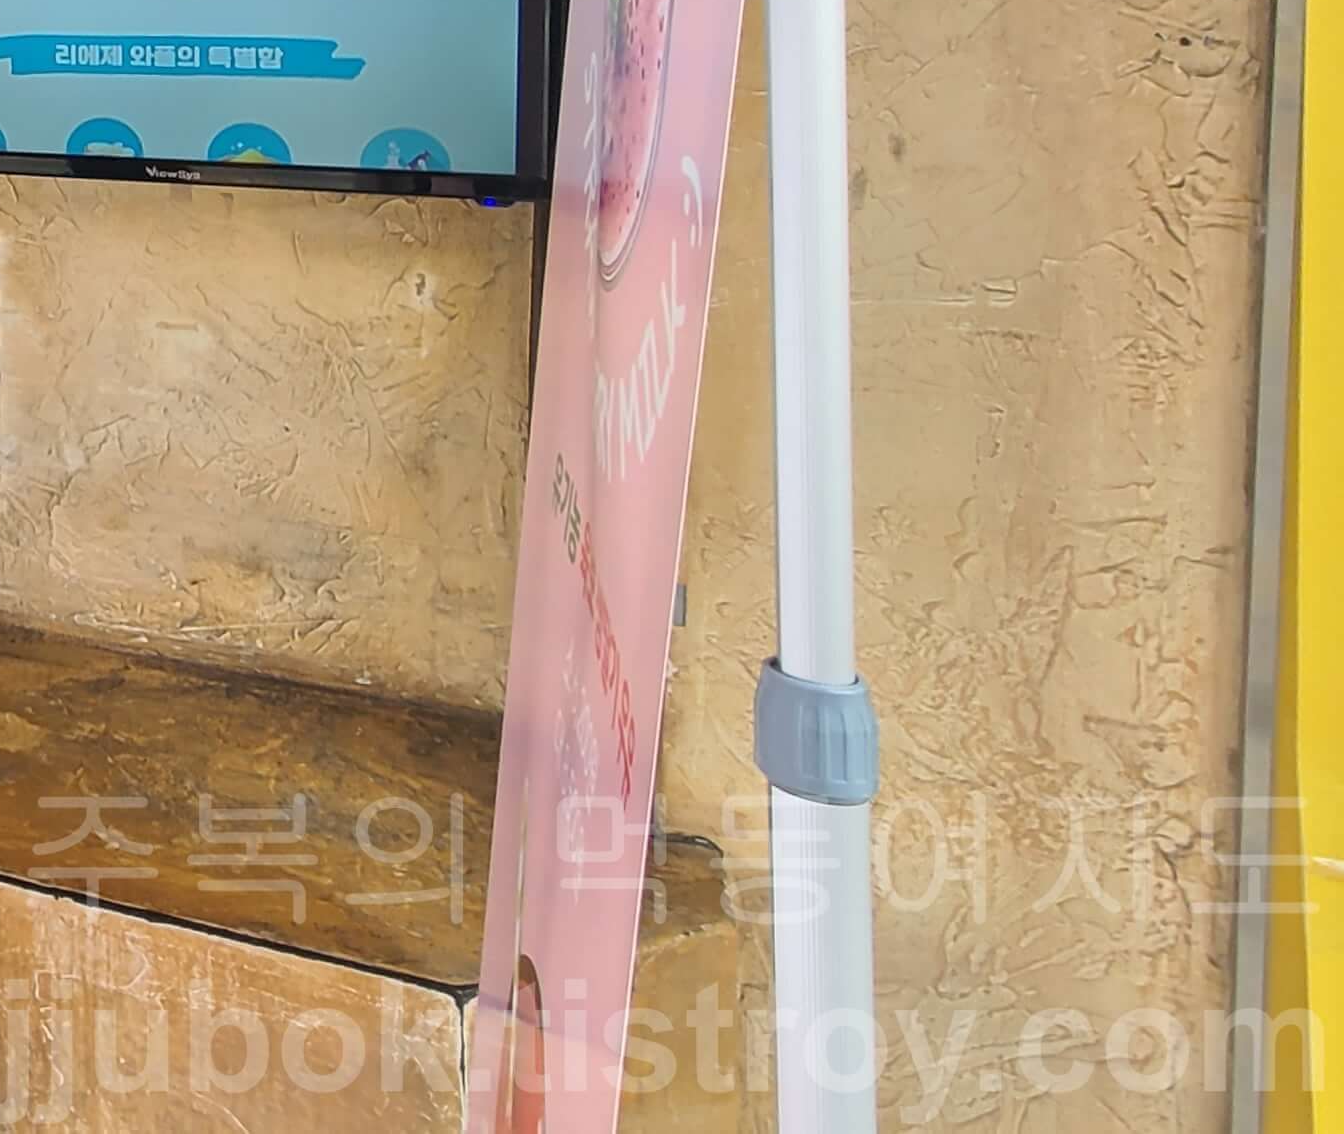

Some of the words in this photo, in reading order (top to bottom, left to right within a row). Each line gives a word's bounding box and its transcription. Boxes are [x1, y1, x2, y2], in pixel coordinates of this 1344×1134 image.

[55, 44, 123, 66] 리에제
[129, 45, 200, 68] 와플의
[208, 46, 284, 69] 특별함
